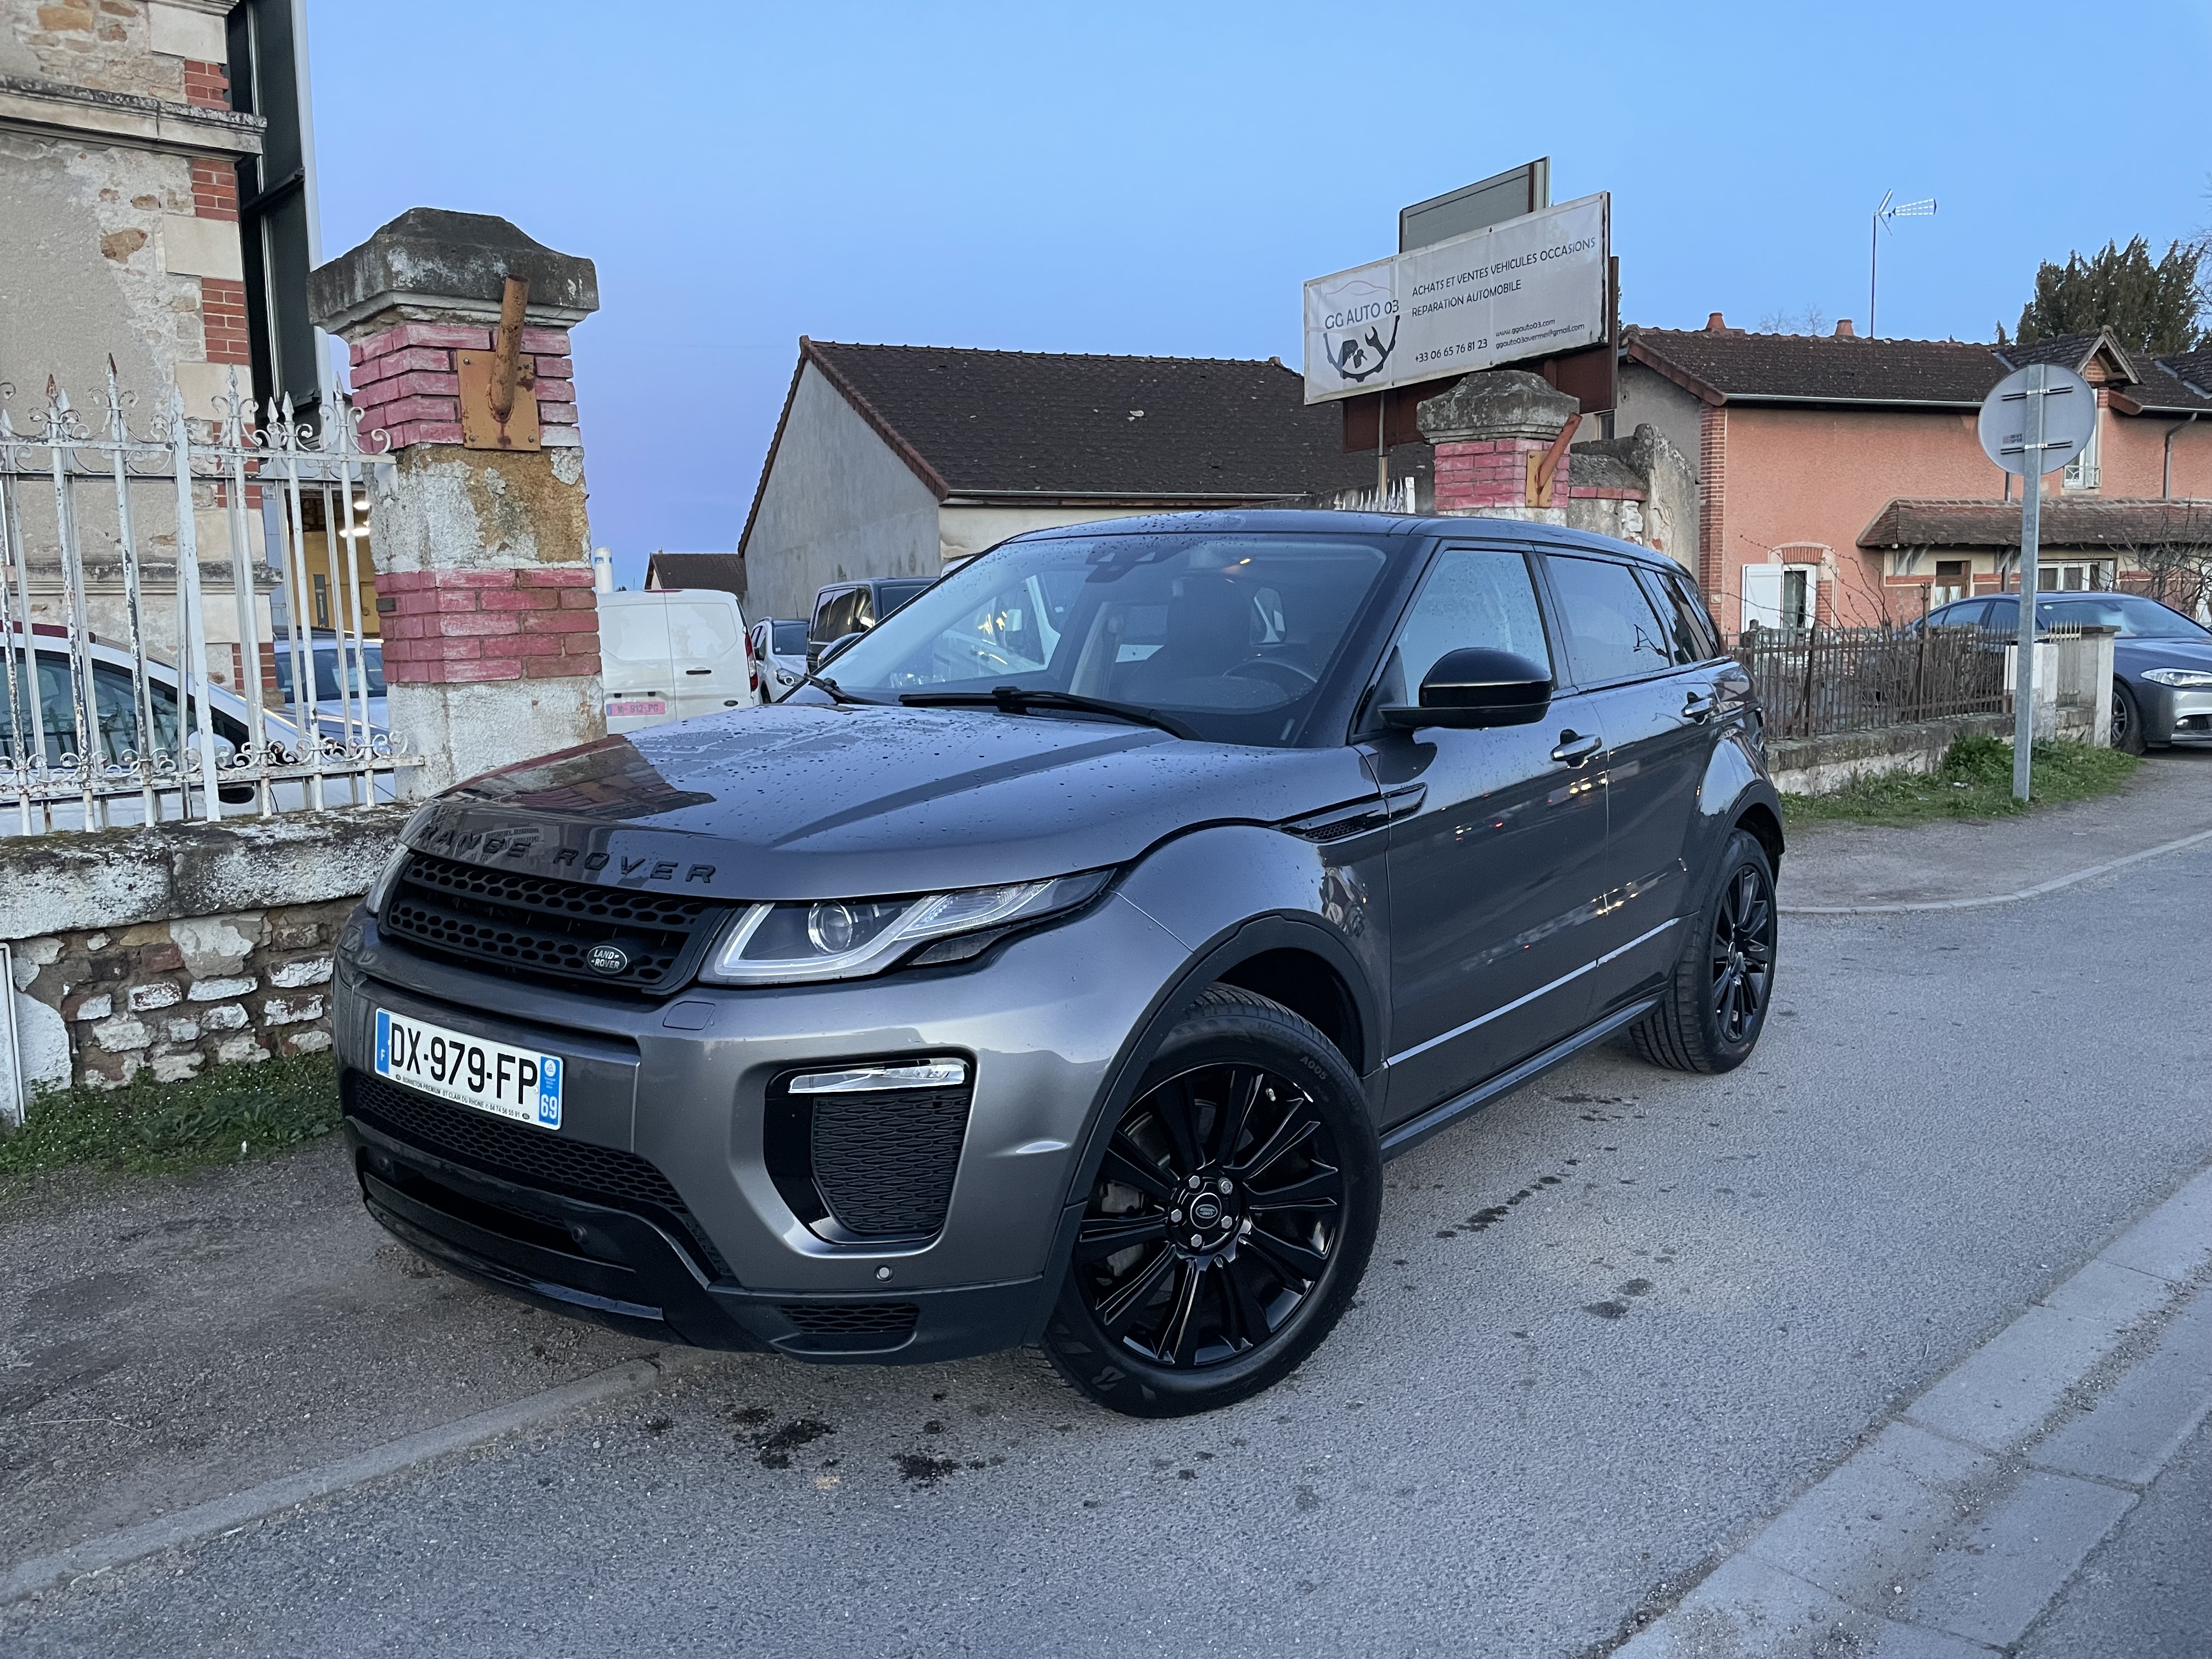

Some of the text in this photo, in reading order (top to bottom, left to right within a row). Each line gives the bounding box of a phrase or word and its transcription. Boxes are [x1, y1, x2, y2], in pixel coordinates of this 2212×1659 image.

[1412, 237, 1595, 297] ACHATS ET VENTES VEHICULES OCCASIONS
[1412, 279, 1522, 317] REPARATION AUTOMOBILE
[1325, 300, 1399, 329] GG AUTO 03
[1496, 319, 1555, 337] www.ggauto03.com
[1415, 338, 1487, 362] +33 06 65 76 81 23
[419, 826, 716, 883] RANGE ROVER
[381, 1048, 385, 1062] F
[391, 1023, 538, 1104] DX-979-FP
[1299, 1056, 1327, 1080] A005
[449, 1091, 461, 1101] CLAIR
[541, 1094, 557, 1119] 69
